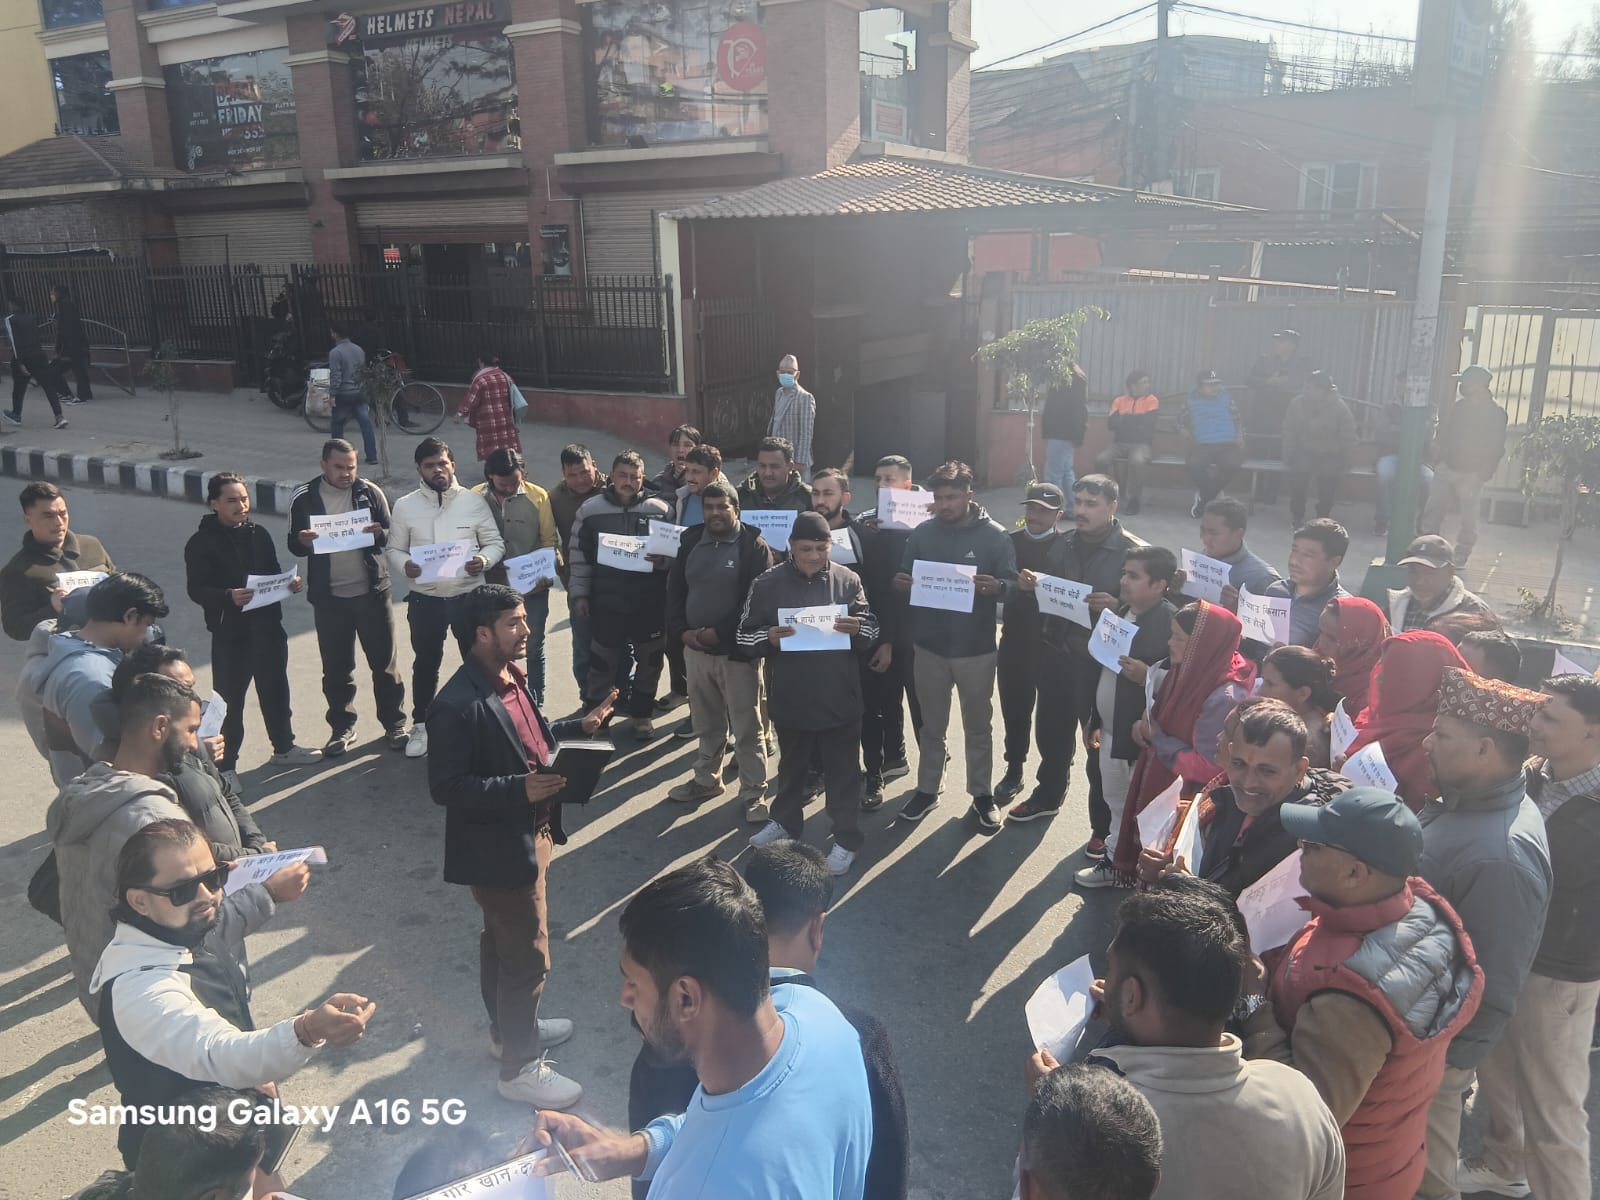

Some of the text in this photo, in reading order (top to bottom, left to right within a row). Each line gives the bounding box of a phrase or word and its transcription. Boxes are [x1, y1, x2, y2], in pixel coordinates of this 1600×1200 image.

[366, 0, 494, 35] HELMETS NEPAL
[217, 104, 263, 125] FRIDAY
[1262, 604, 1288, 618] किसान
[479, 1167, 511, 1188] खान
